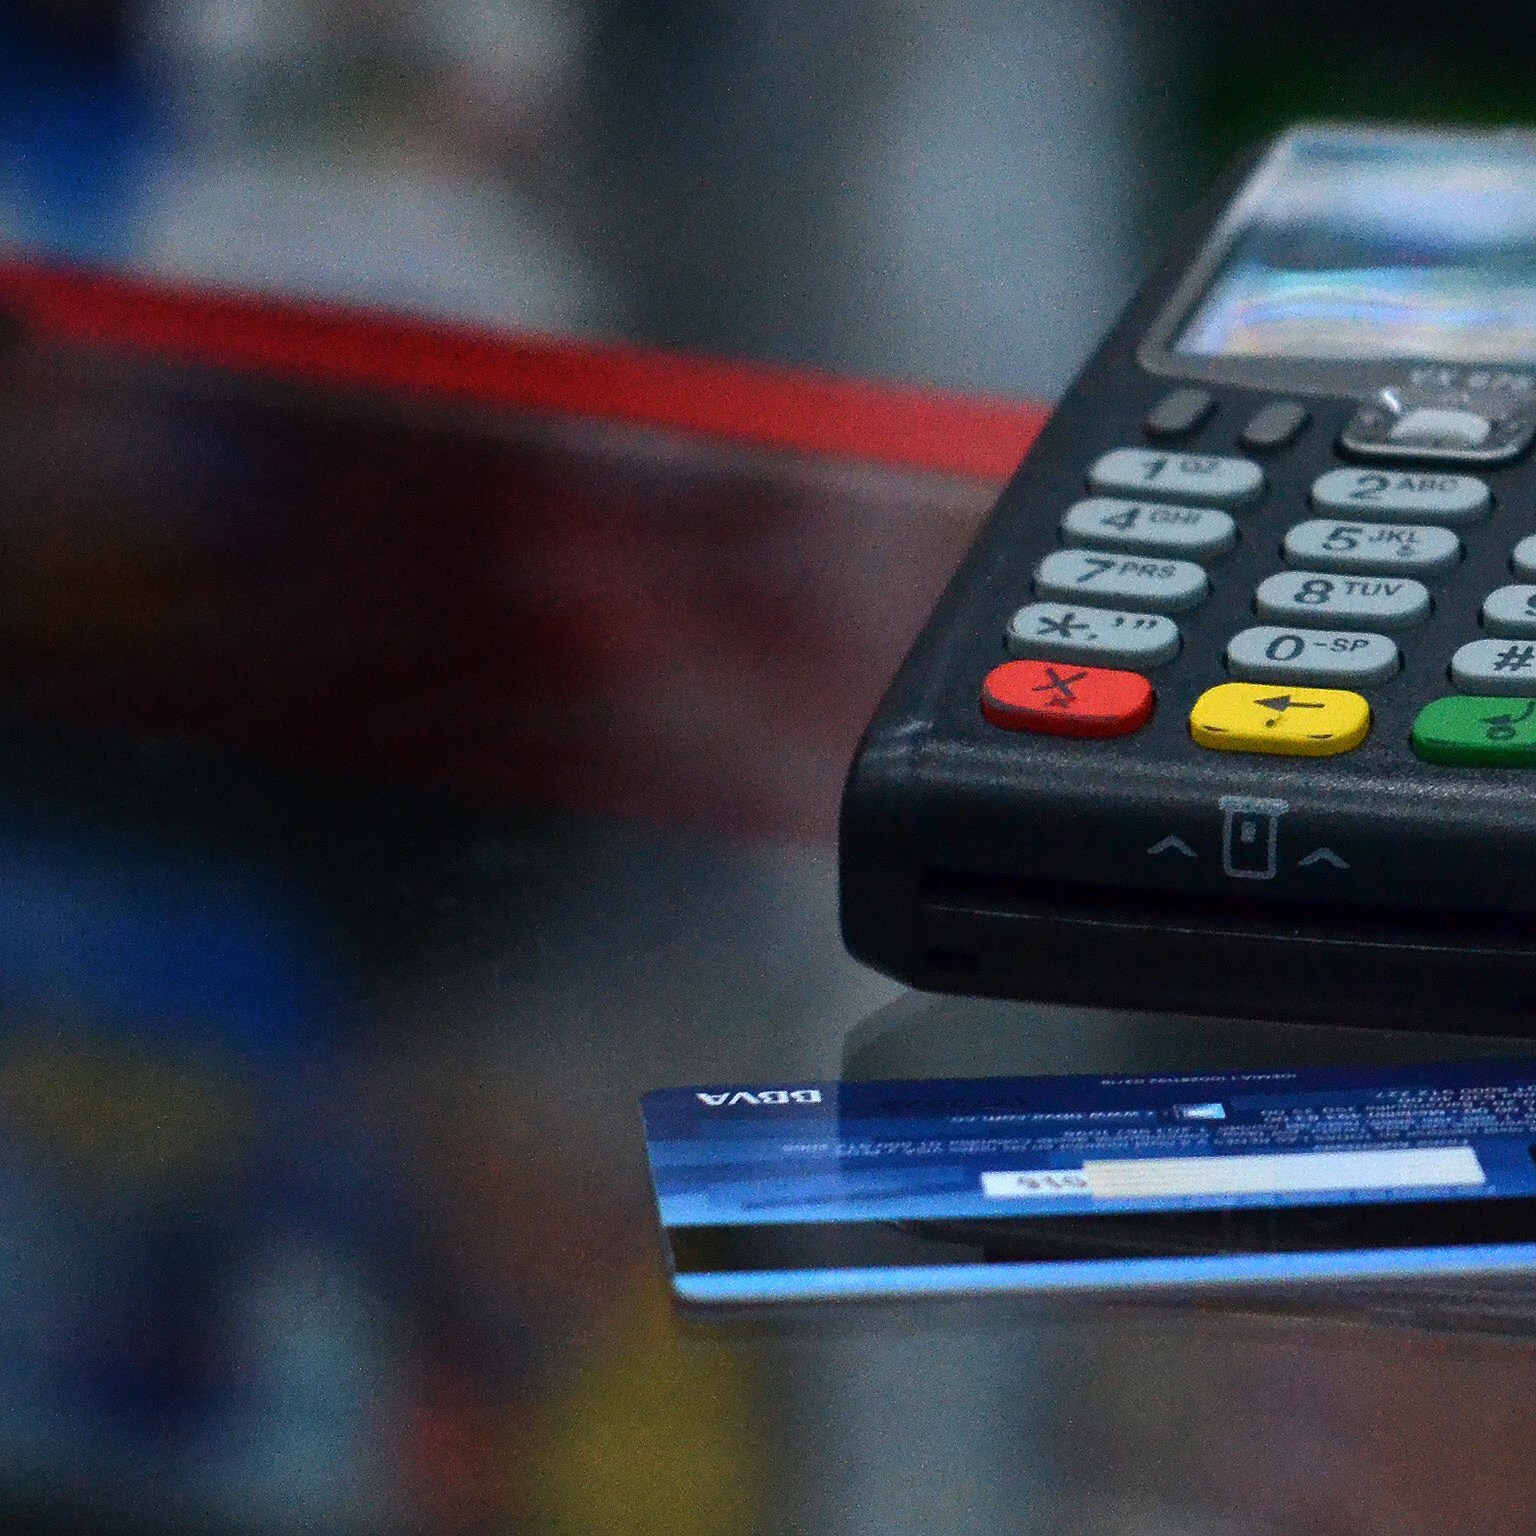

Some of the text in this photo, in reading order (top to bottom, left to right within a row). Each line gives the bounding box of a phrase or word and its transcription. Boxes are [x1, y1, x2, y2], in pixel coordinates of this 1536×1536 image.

[1141, 457, 1168, 481] 1
[1350, 475, 1459, 501] 2 ABC
[1101, 507, 1202, 532] 4 GHI
[1322, 526, 1422, 552] 5 JKL
[1077, 556, 1177, 584] 7 PRS
[1294, 578, 1403, 606] 8 TUV
[1265, 634, 1306, 662] 0
[1493, 644, 1536, 672] #
[694, 1089, 822, 1107] BBVA
